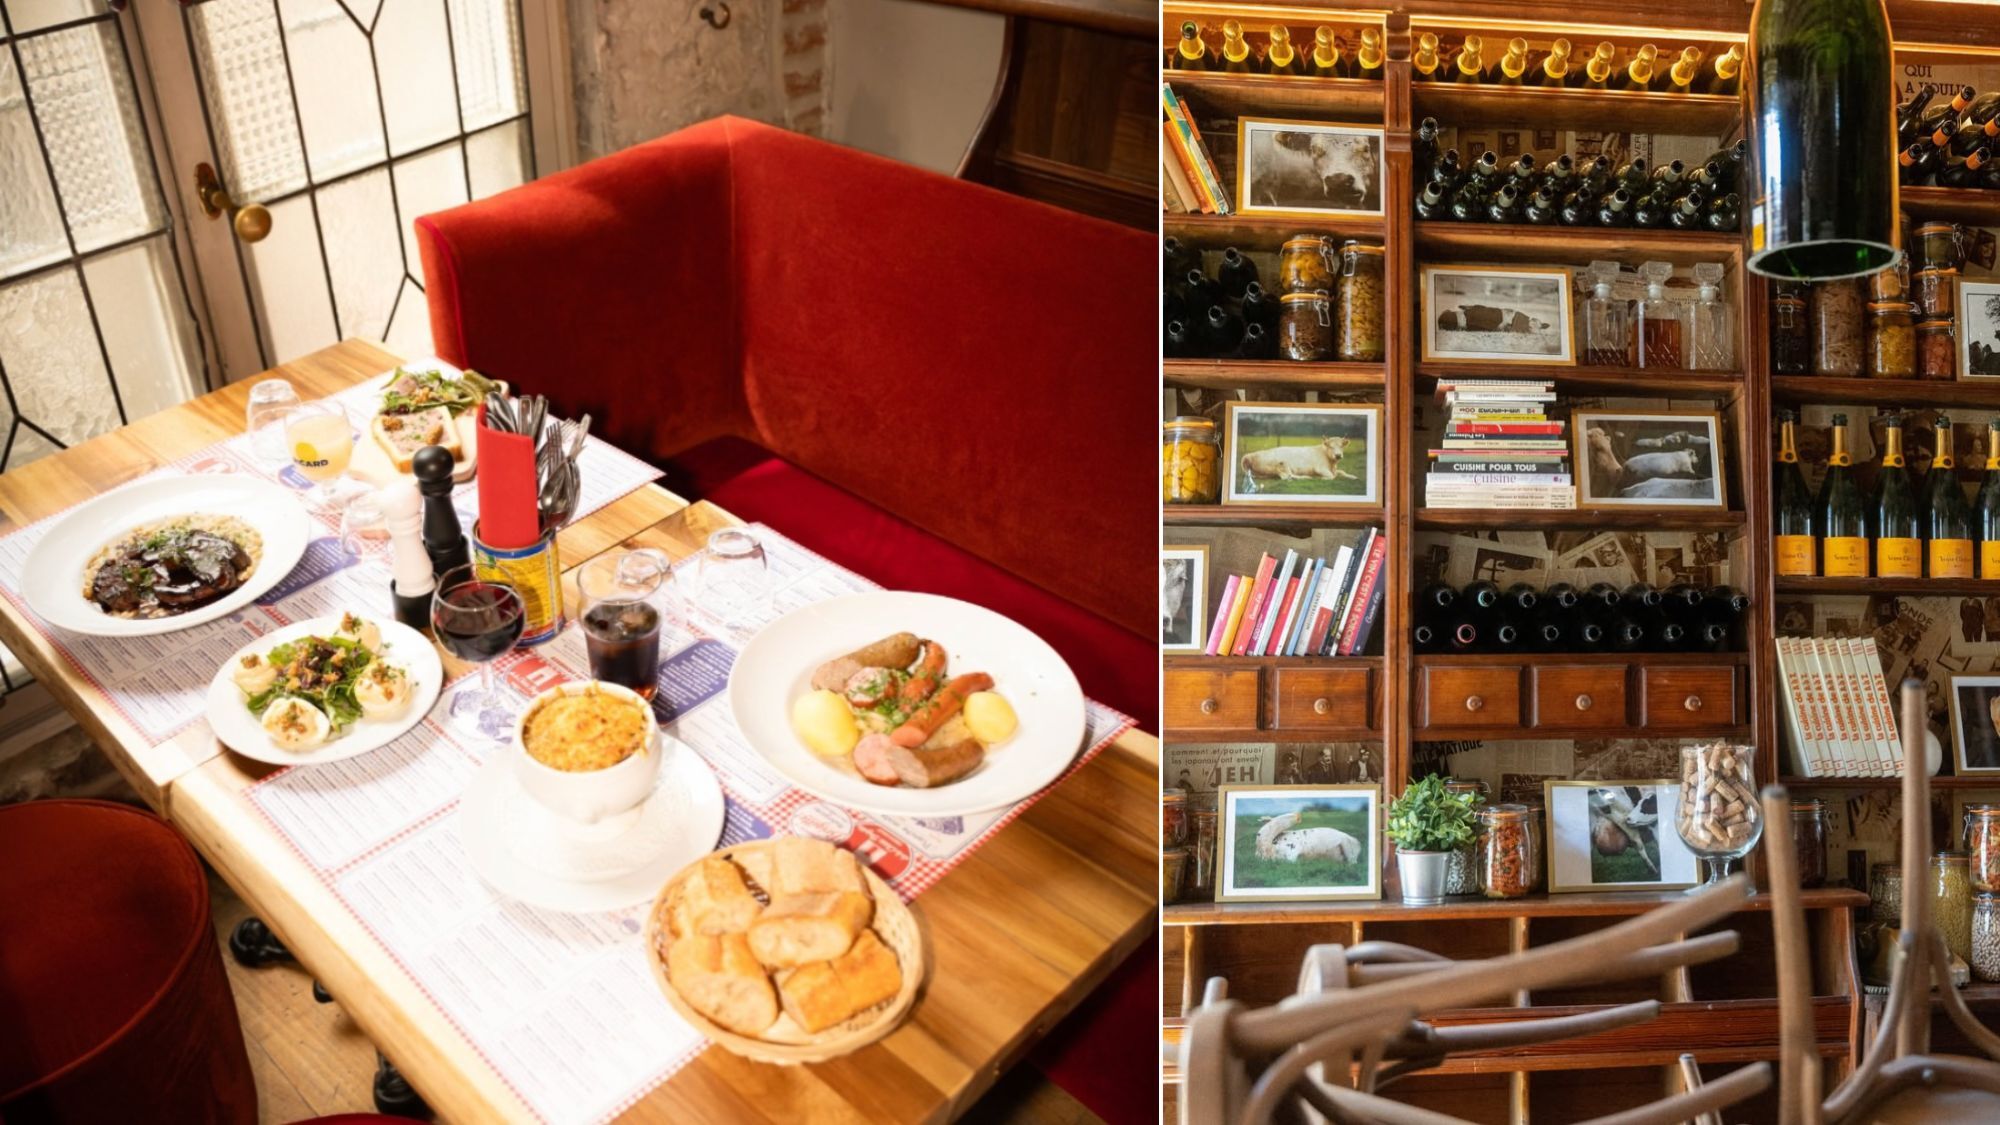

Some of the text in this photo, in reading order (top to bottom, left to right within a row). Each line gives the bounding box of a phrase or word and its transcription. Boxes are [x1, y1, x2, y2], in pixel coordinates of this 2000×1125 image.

[1905, 64, 1932, 78] QUI
[1905, 81, 1914, 93] A
[1453, 463, 1537, 472] CUISINE POUR TOUS
[1372, 548, 1381, 559] LE
[1367, 557, 1378, 574] VIN
[1354, 596, 1365, 613] PAS
[1899, 600, 1934, 628] ONDE
[1223, 748, 1262, 756] pourquoi
[1210, 766, 1255, 788] JEH
